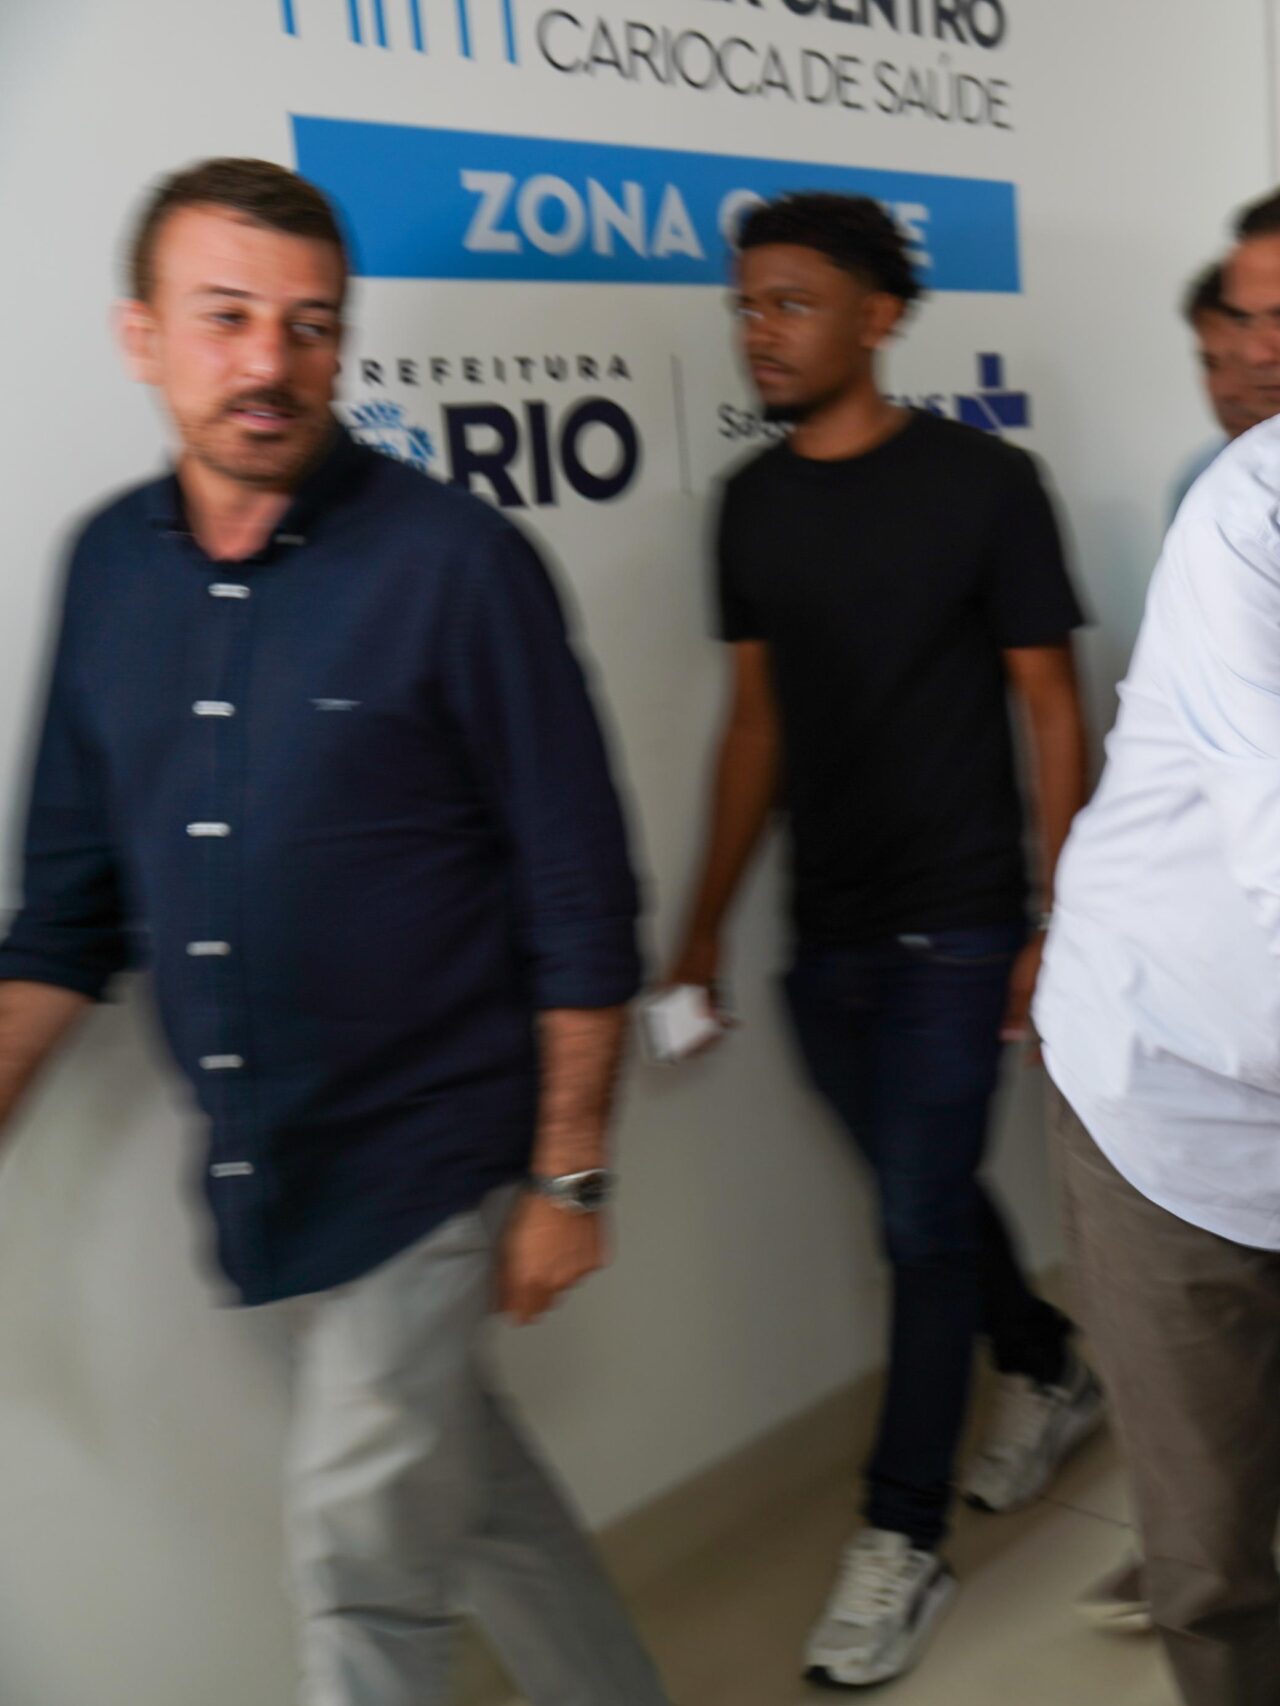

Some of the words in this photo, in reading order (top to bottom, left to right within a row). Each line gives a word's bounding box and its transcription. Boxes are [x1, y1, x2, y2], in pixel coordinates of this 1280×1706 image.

[537, 8, 796, 102] CARIOCA
[801, 49, 864, 111] DE
[874, 53, 1013, 130] SAÚDE
[784, 0, 1006, 48] NTRO
[461, 169, 705, 260] ZONA
[359, 354, 632, 388] REFEITURA
[441, 396, 641, 510] RIO
